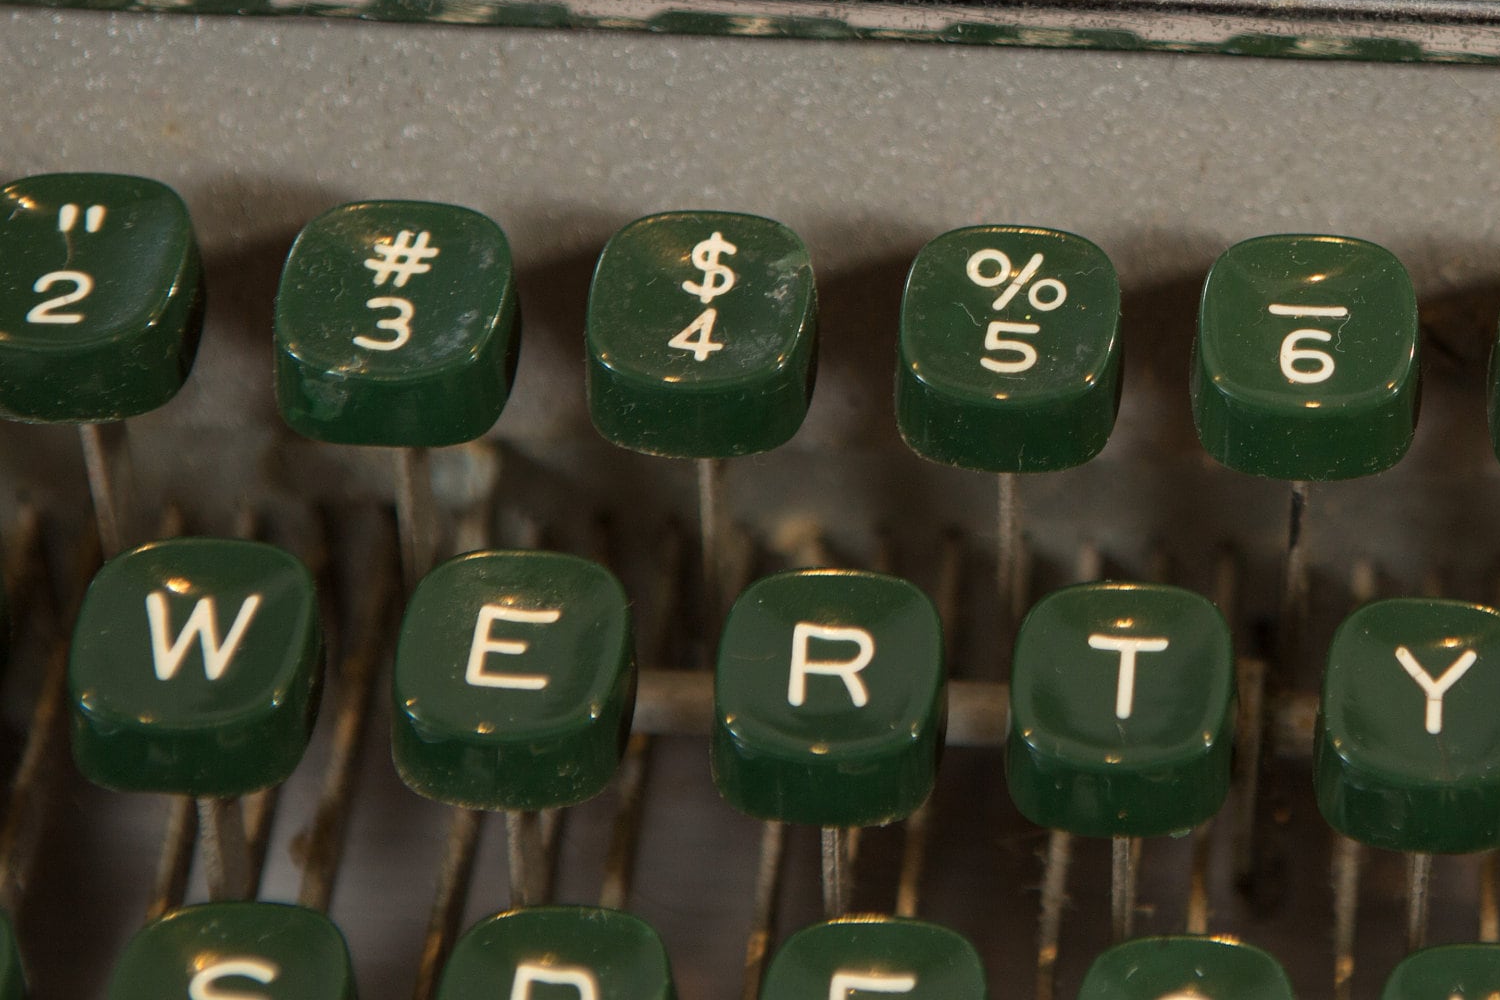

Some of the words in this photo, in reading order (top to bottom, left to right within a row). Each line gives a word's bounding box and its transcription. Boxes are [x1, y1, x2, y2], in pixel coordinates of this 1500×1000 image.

[363, 229, 440, 288] #
[680, 230, 738, 305] $
[965, 246, 1068, 312] %
[25, 268, 94, 326] 2
[351, 295, 414, 352] 3
[666, 307, 725, 363] 4
[979, 319, 1042, 375] 5
[1278, 327, 1337, 386] 6
[144, 590, 262, 682] W
[464, 604, 562, 691] E
[786, 621, 875, 708] R
[1086, 634, 1170, 720] T
[1394, 645, 1478, 736] Y
